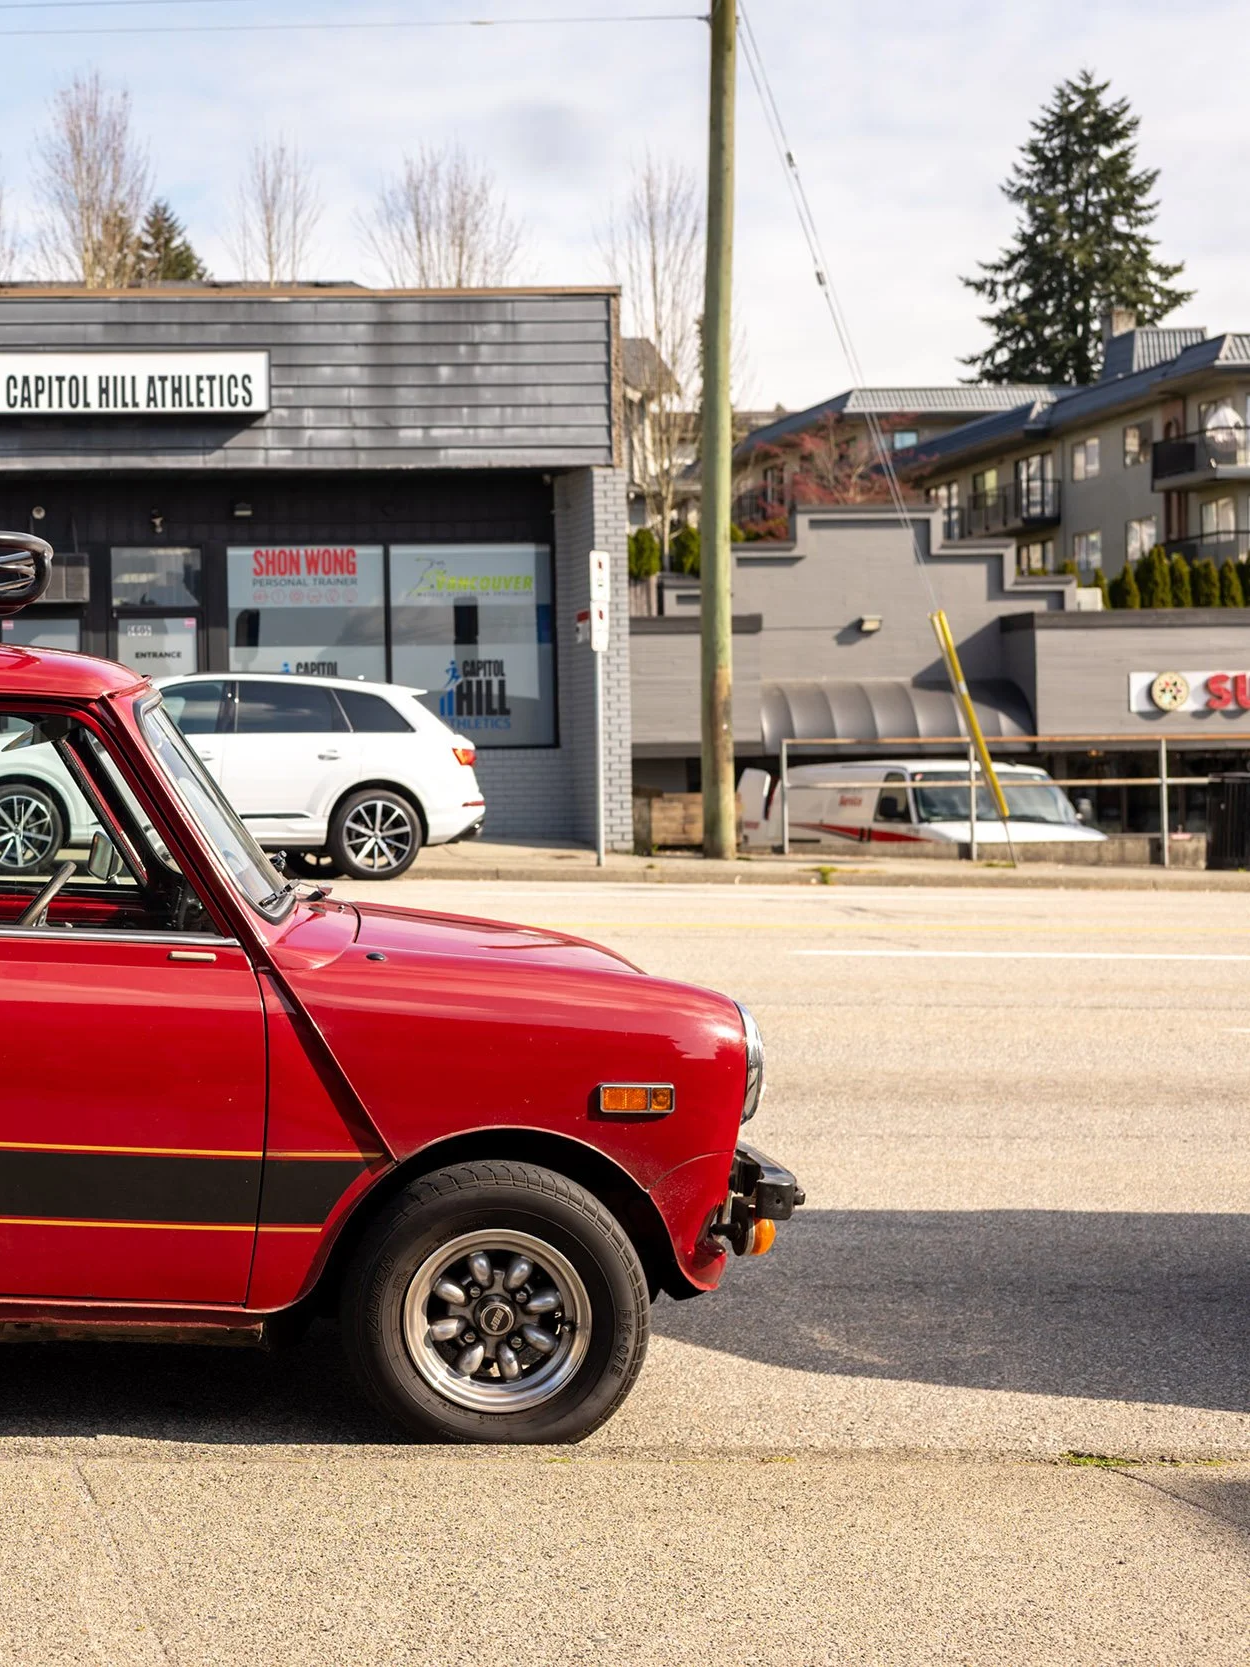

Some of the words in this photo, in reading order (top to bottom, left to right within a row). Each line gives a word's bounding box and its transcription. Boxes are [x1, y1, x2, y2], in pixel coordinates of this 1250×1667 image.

[6, 374, 91, 409] CAPITOL
[98, 374, 140, 409] HILL
[146, 373, 253, 408] ATHLETICS
[253, 549, 300, 577] SHON
[304, 548, 357, 576] WONG
[252, 577, 308, 587] PERSONAL
[313, 577, 358, 586] TRAINER
[435, 575, 533, 592] VANCOUVER
[135, 651, 182, 660] ENTRANCE
[296, 661, 338, 677] CAPITOL
[462, 660, 506, 677] CAPITOL
[456, 679, 511, 716] HILL
[450, 717, 511, 730] THLETICS
